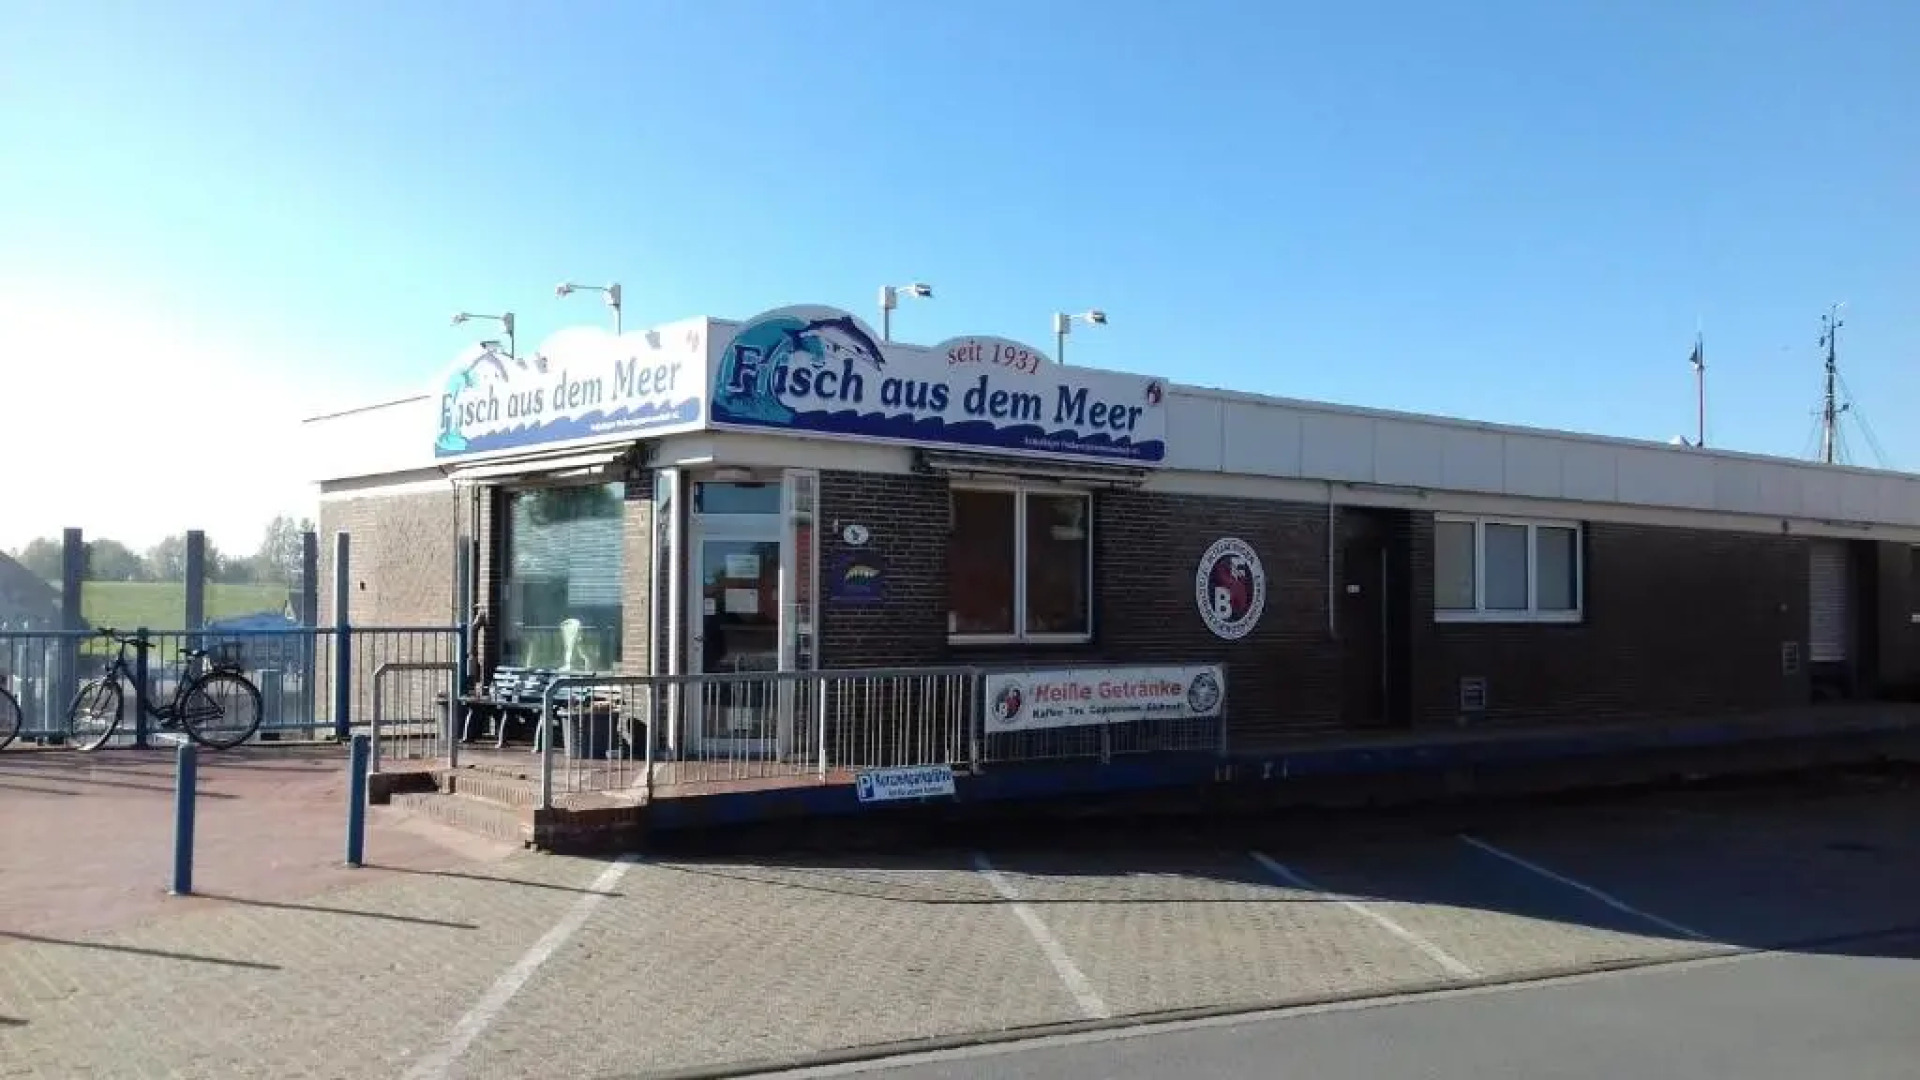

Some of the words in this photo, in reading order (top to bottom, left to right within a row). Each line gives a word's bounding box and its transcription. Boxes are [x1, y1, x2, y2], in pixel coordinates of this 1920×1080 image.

[947, 340, 983, 364] seit
[992, 345, 1041, 374] 1931
[507, 388, 544, 418] aus
[553, 368, 603, 410] dem
[612, 356, 681, 400] Meer
[881, 377, 949, 411] aus
[964, 374, 1041, 420] dem
[1054, 385, 1142, 430] Meer
[1098, 680, 1182, 699] Getränke
